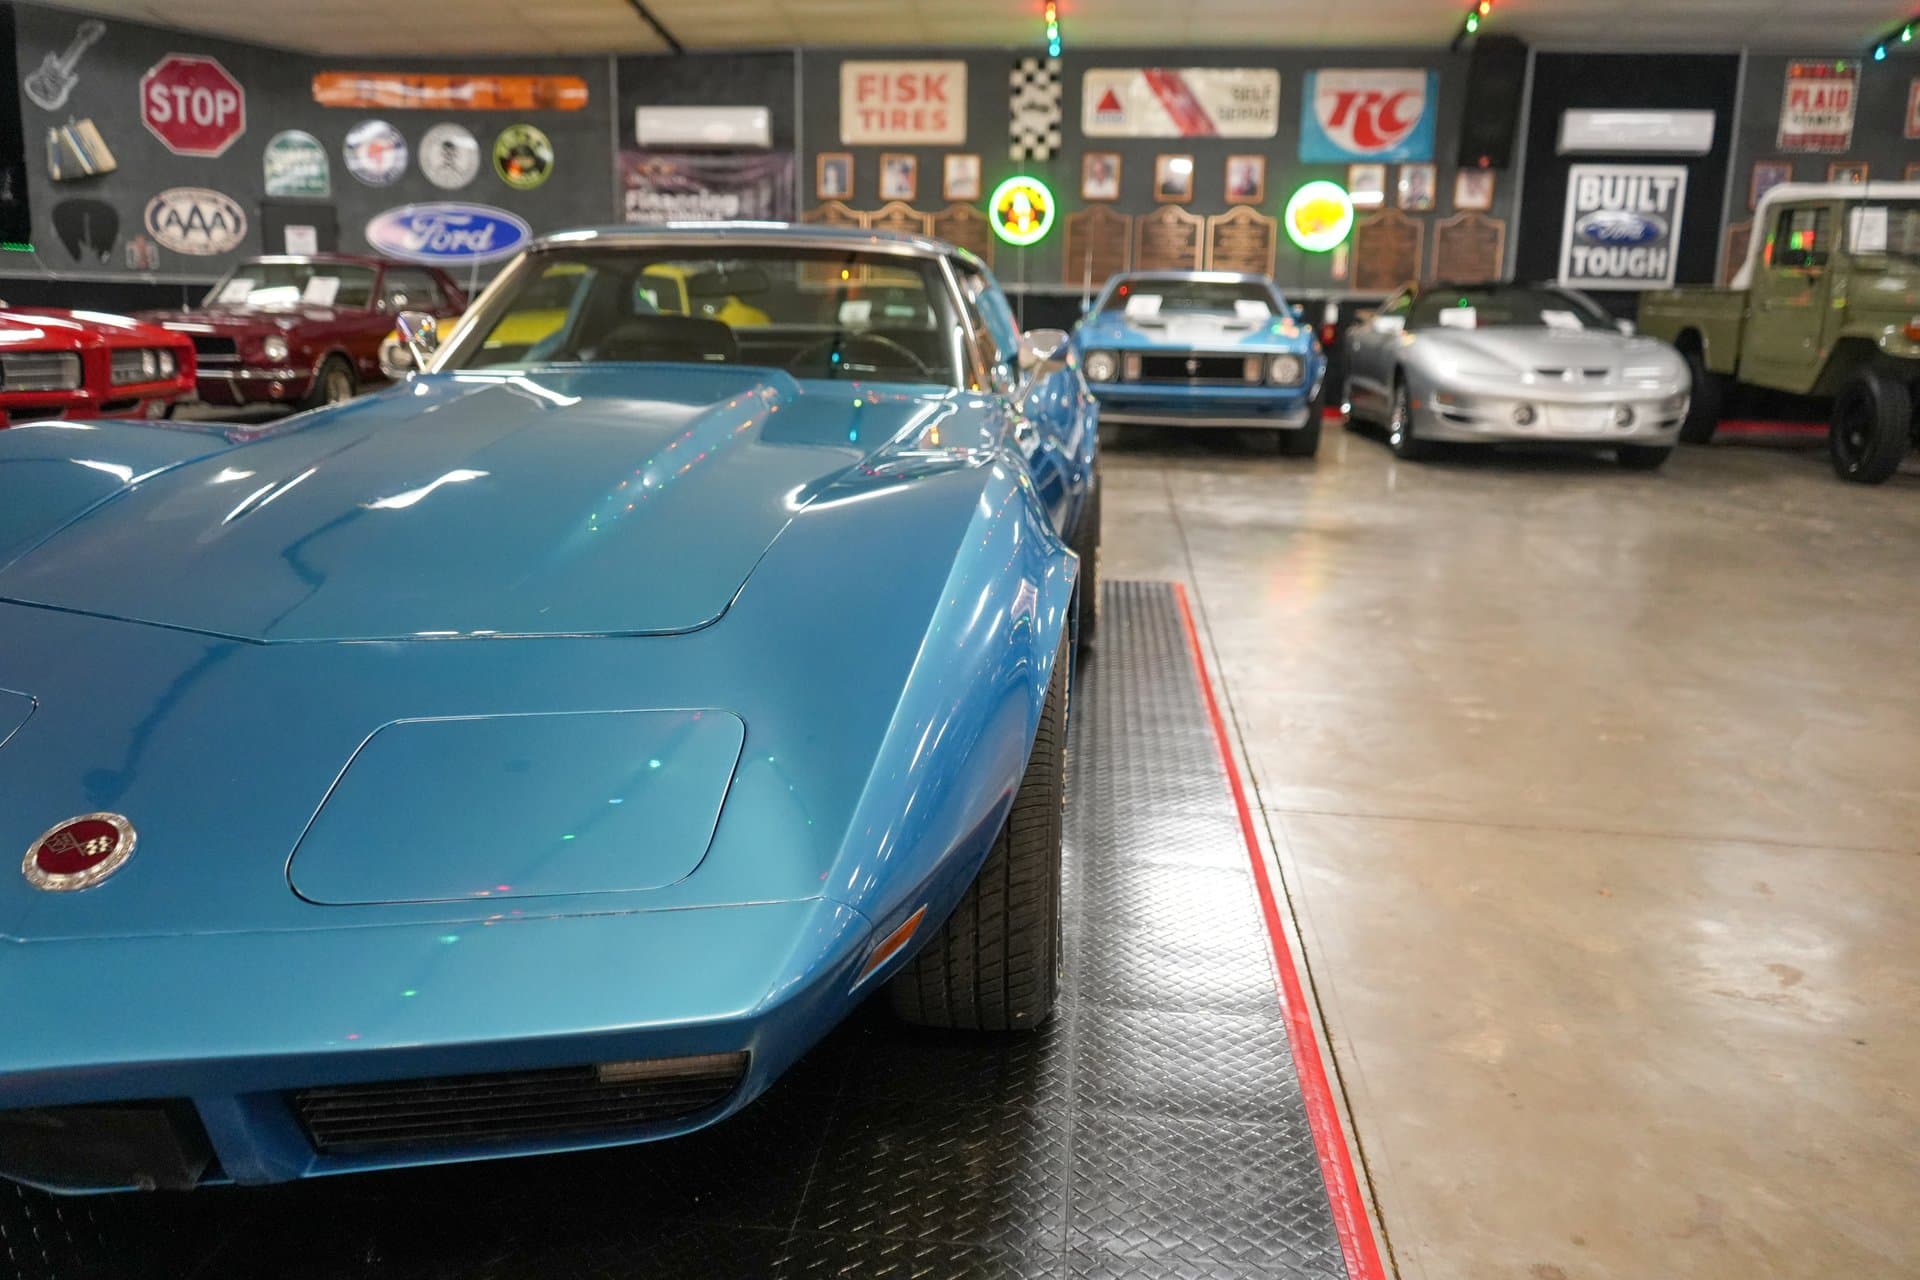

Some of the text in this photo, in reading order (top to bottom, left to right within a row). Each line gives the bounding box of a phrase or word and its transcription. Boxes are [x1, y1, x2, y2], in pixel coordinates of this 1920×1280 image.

[150, 84, 237, 127] STOP
[857, 74, 948, 103] FISK
[1791, 88, 1849, 112] PLAID
[858, 108, 947, 131] TIRES
[1321, 89, 1420, 148] RC
[1578, 176, 1676, 212] BUILT
[165, 204, 227, 239] AAA
[402, 212, 495, 251] Ford
[1573, 246, 1667, 278] TOUGH
